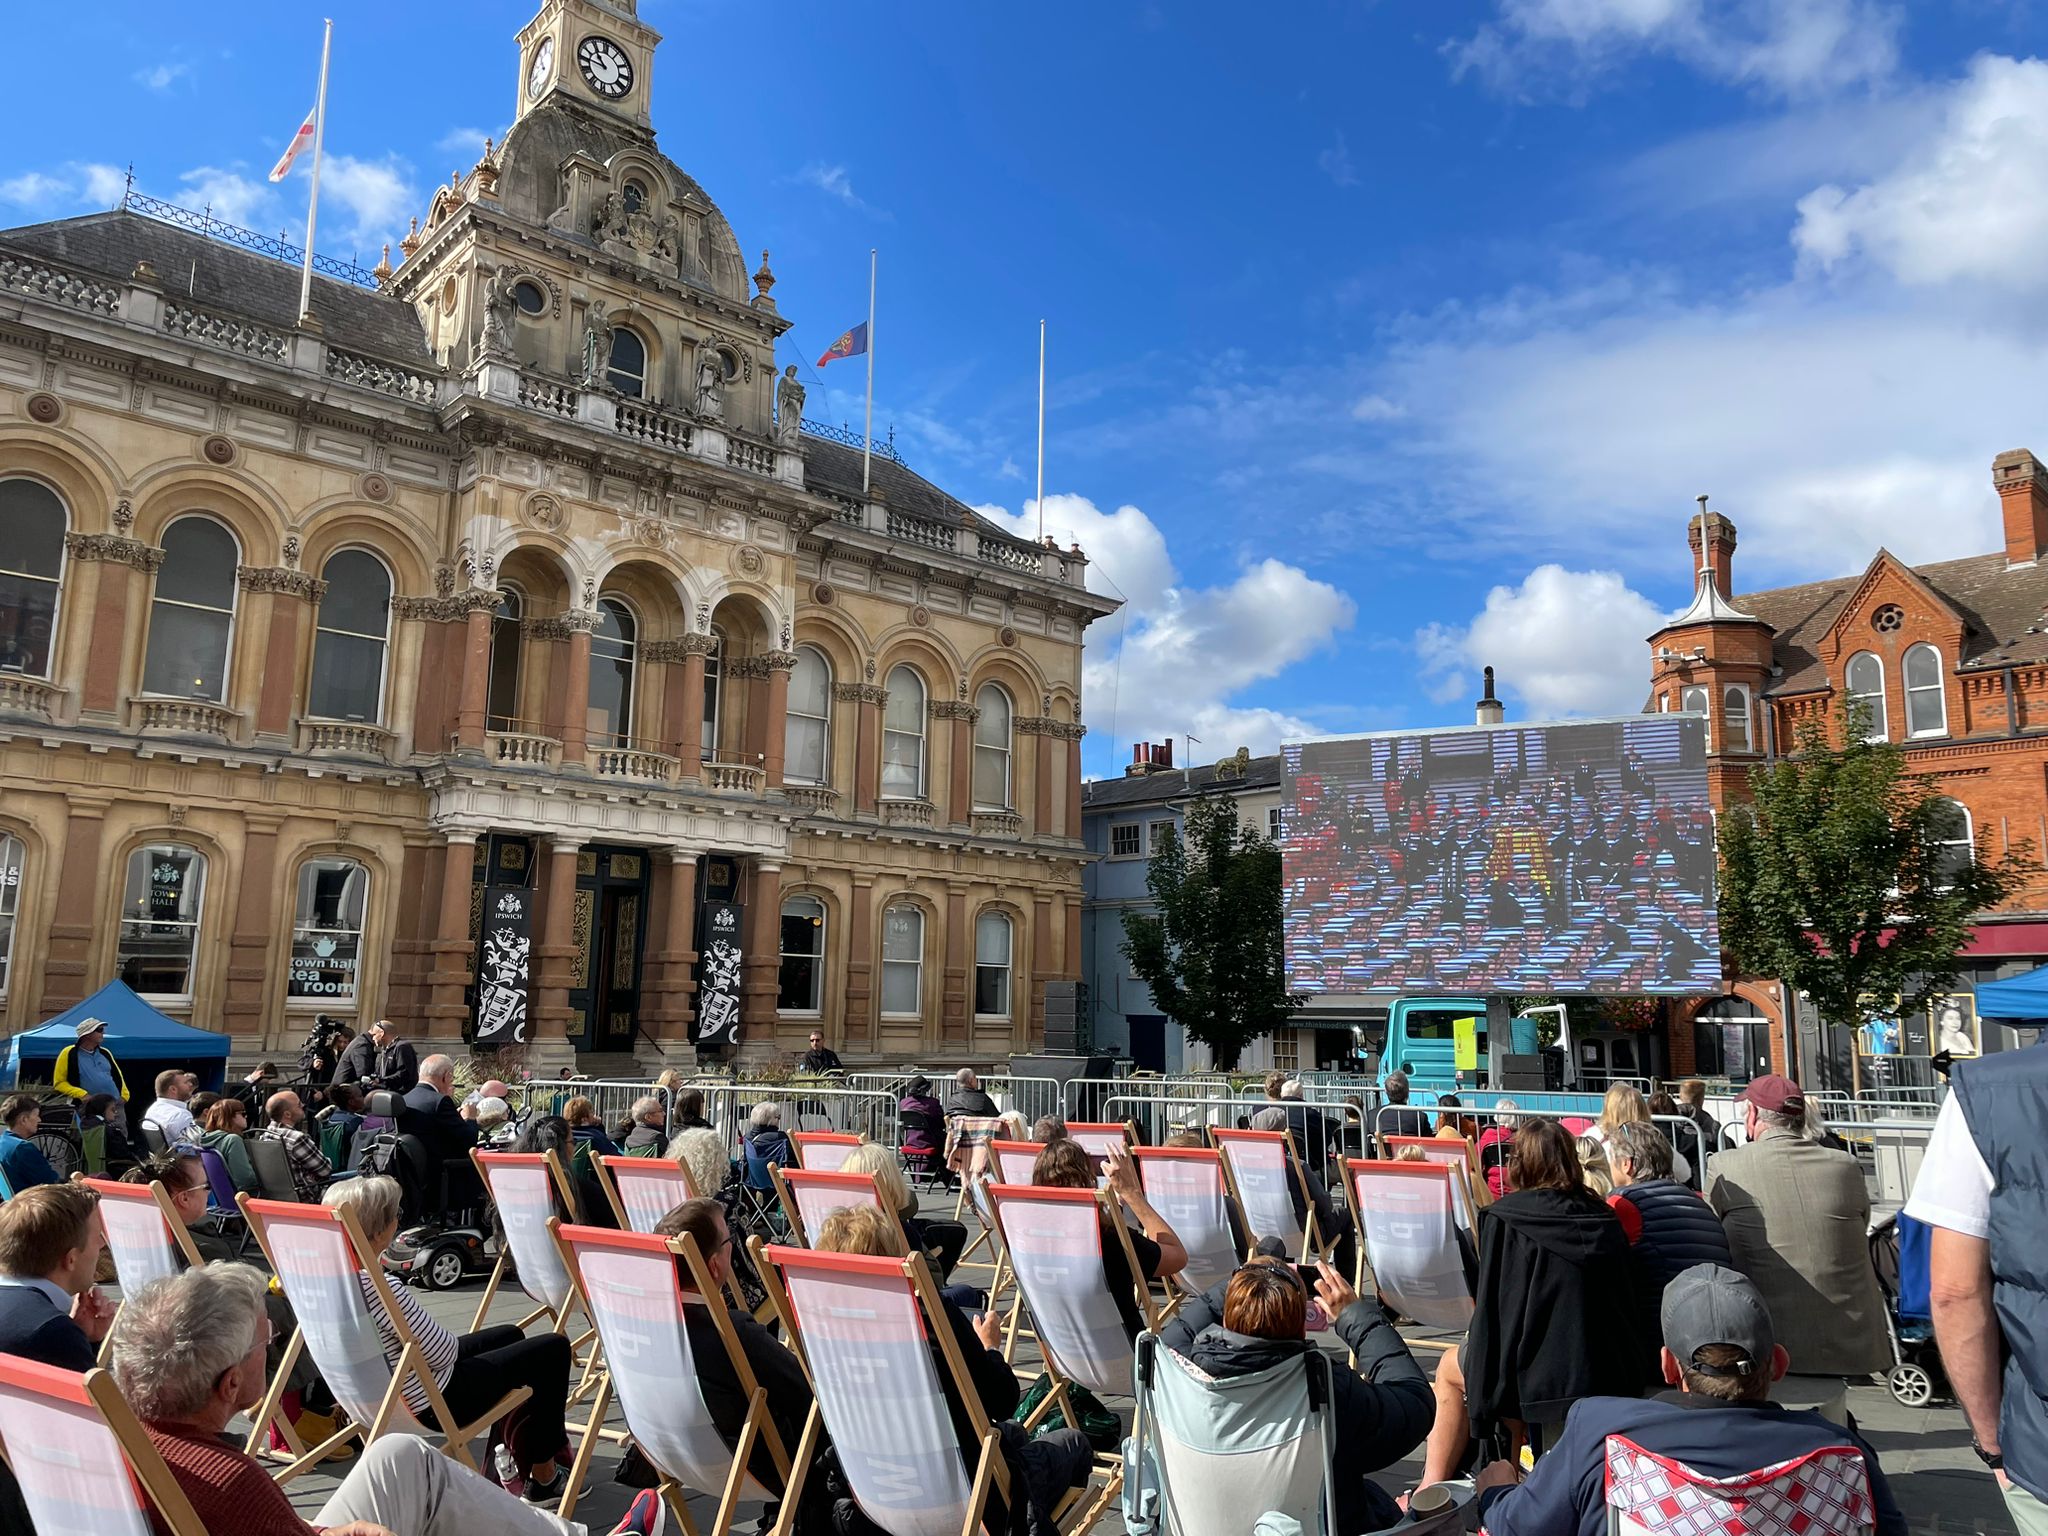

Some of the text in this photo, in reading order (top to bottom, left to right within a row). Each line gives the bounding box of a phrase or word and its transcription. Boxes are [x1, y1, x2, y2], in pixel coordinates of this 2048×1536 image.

[151, 898, 174, 906] HALL
[288, 967, 321, 981] tea
[303, 981, 354, 994] room
